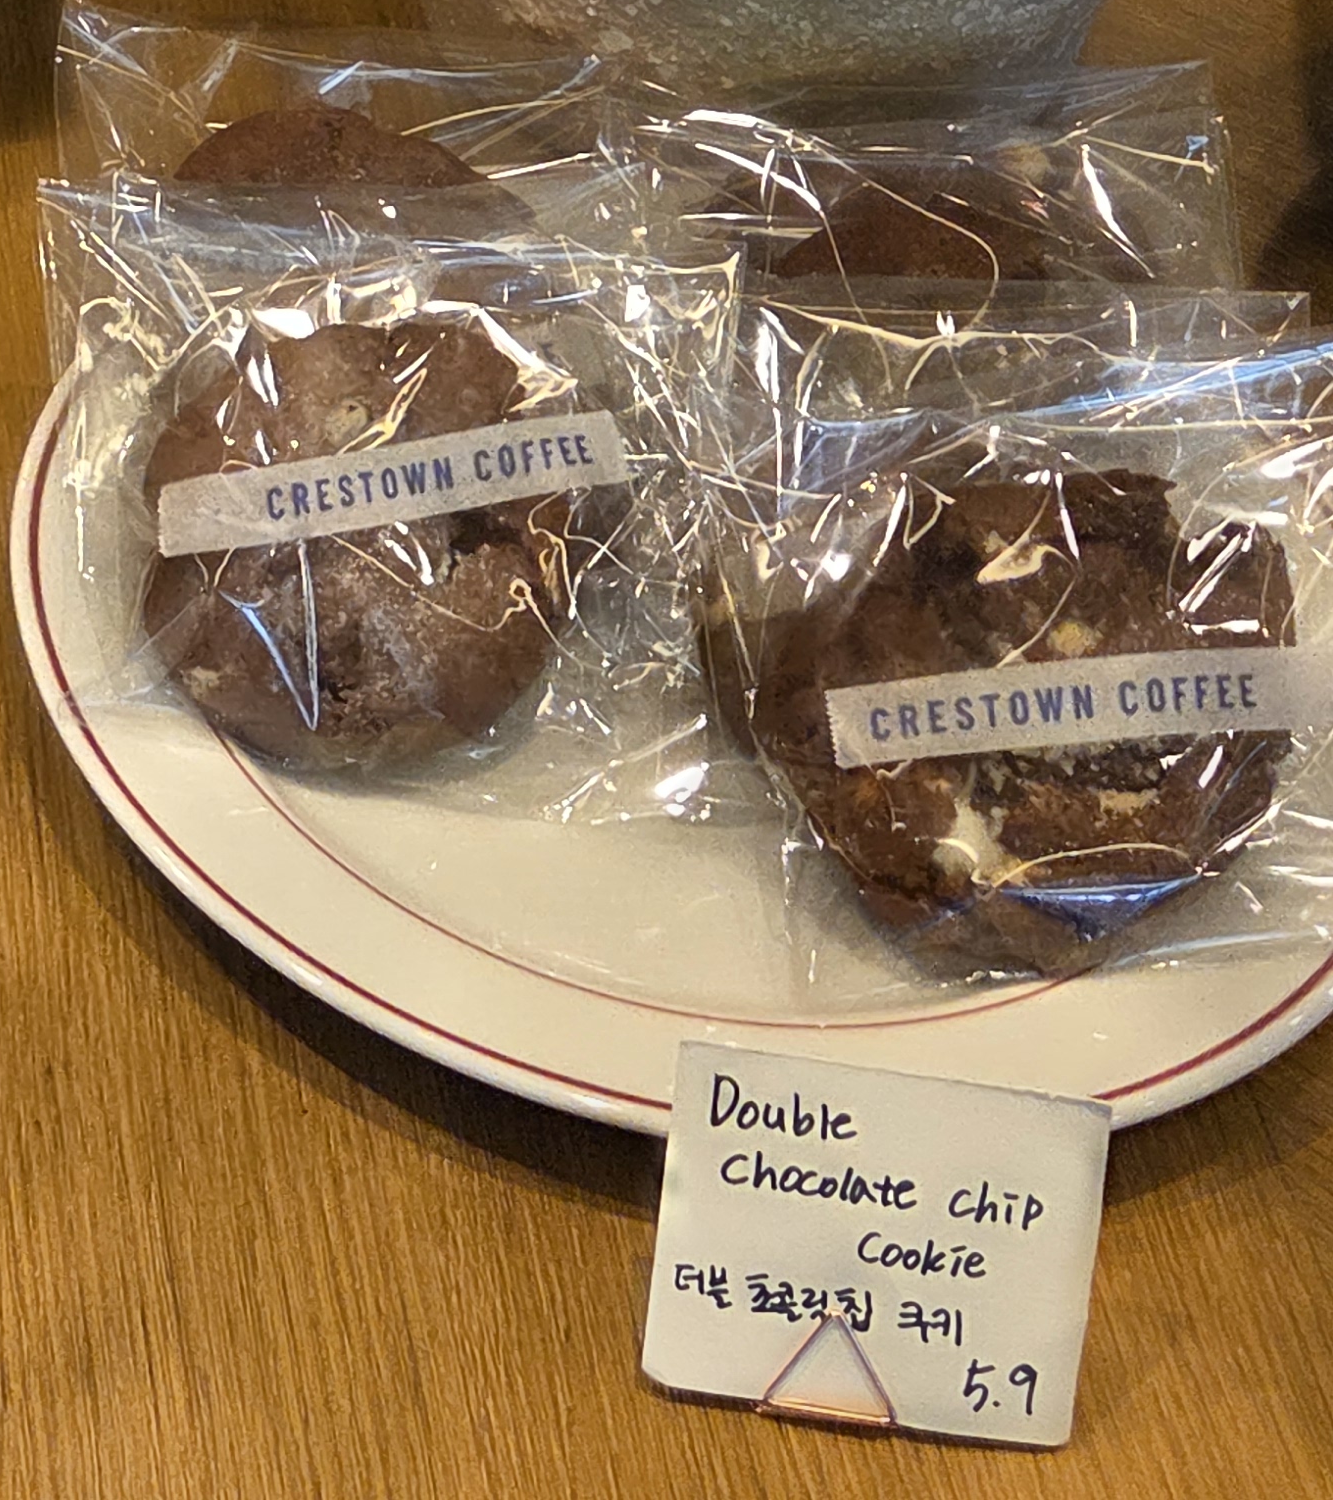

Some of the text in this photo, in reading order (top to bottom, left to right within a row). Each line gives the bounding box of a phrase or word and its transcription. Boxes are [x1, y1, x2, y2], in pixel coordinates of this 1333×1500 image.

[266, 434, 594, 521] CRESTOWN COFFEE
[869, 673, 1257, 741] CRESTOWN COFFEE
[710, 1073, 858, 1142] Double
[962, 1358, 1038, 1415] 5.9
